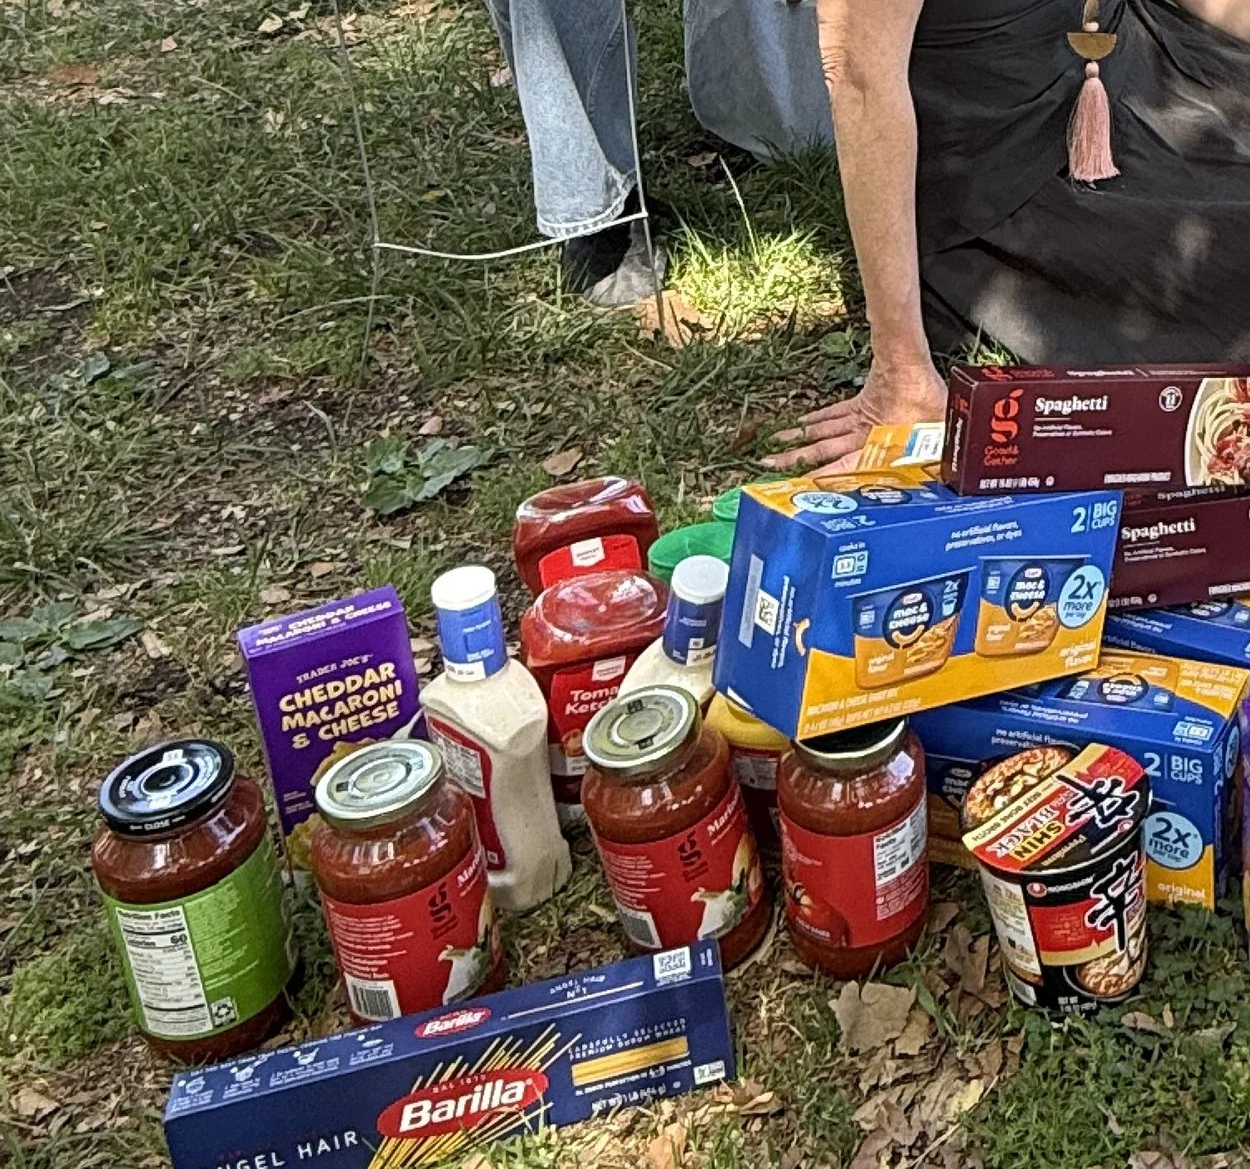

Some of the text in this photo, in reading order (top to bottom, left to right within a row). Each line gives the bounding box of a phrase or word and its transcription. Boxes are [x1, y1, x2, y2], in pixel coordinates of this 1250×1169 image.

[1034, 395, 1109, 415] Spaghetti
[1070, 500, 1117, 533] 2 BIG
[1091, 516, 1116, 529] CUPS
[1121, 517, 1196, 542] Spaghetti
[1067, 574, 1098, 600] 2x
[1063, 601, 1094, 612] more
[296, 663, 338, 684] TRADER
[278, 662, 397, 713] CHEDDAR
[281, 679, 403, 732] MACARONI
[291, 701, 400, 749] & CHEESE
[1144, 752, 1203, 777] 2 BIG
[1170, 770, 1203, 785] CUPS
[986, 803, 1061, 857] BLACK
[1014, 821, 1064, 859] SHIN
[1152, 817, 1192, 849] 2x
[1149, 837, 1190, 860] more
[1157, 881, 1206, 899] original
[422, 1010, 486, 1036] Barilla
[400, 1078, 527, 1133] Barilla
[296, 1130, 359, 1160] HAIR
